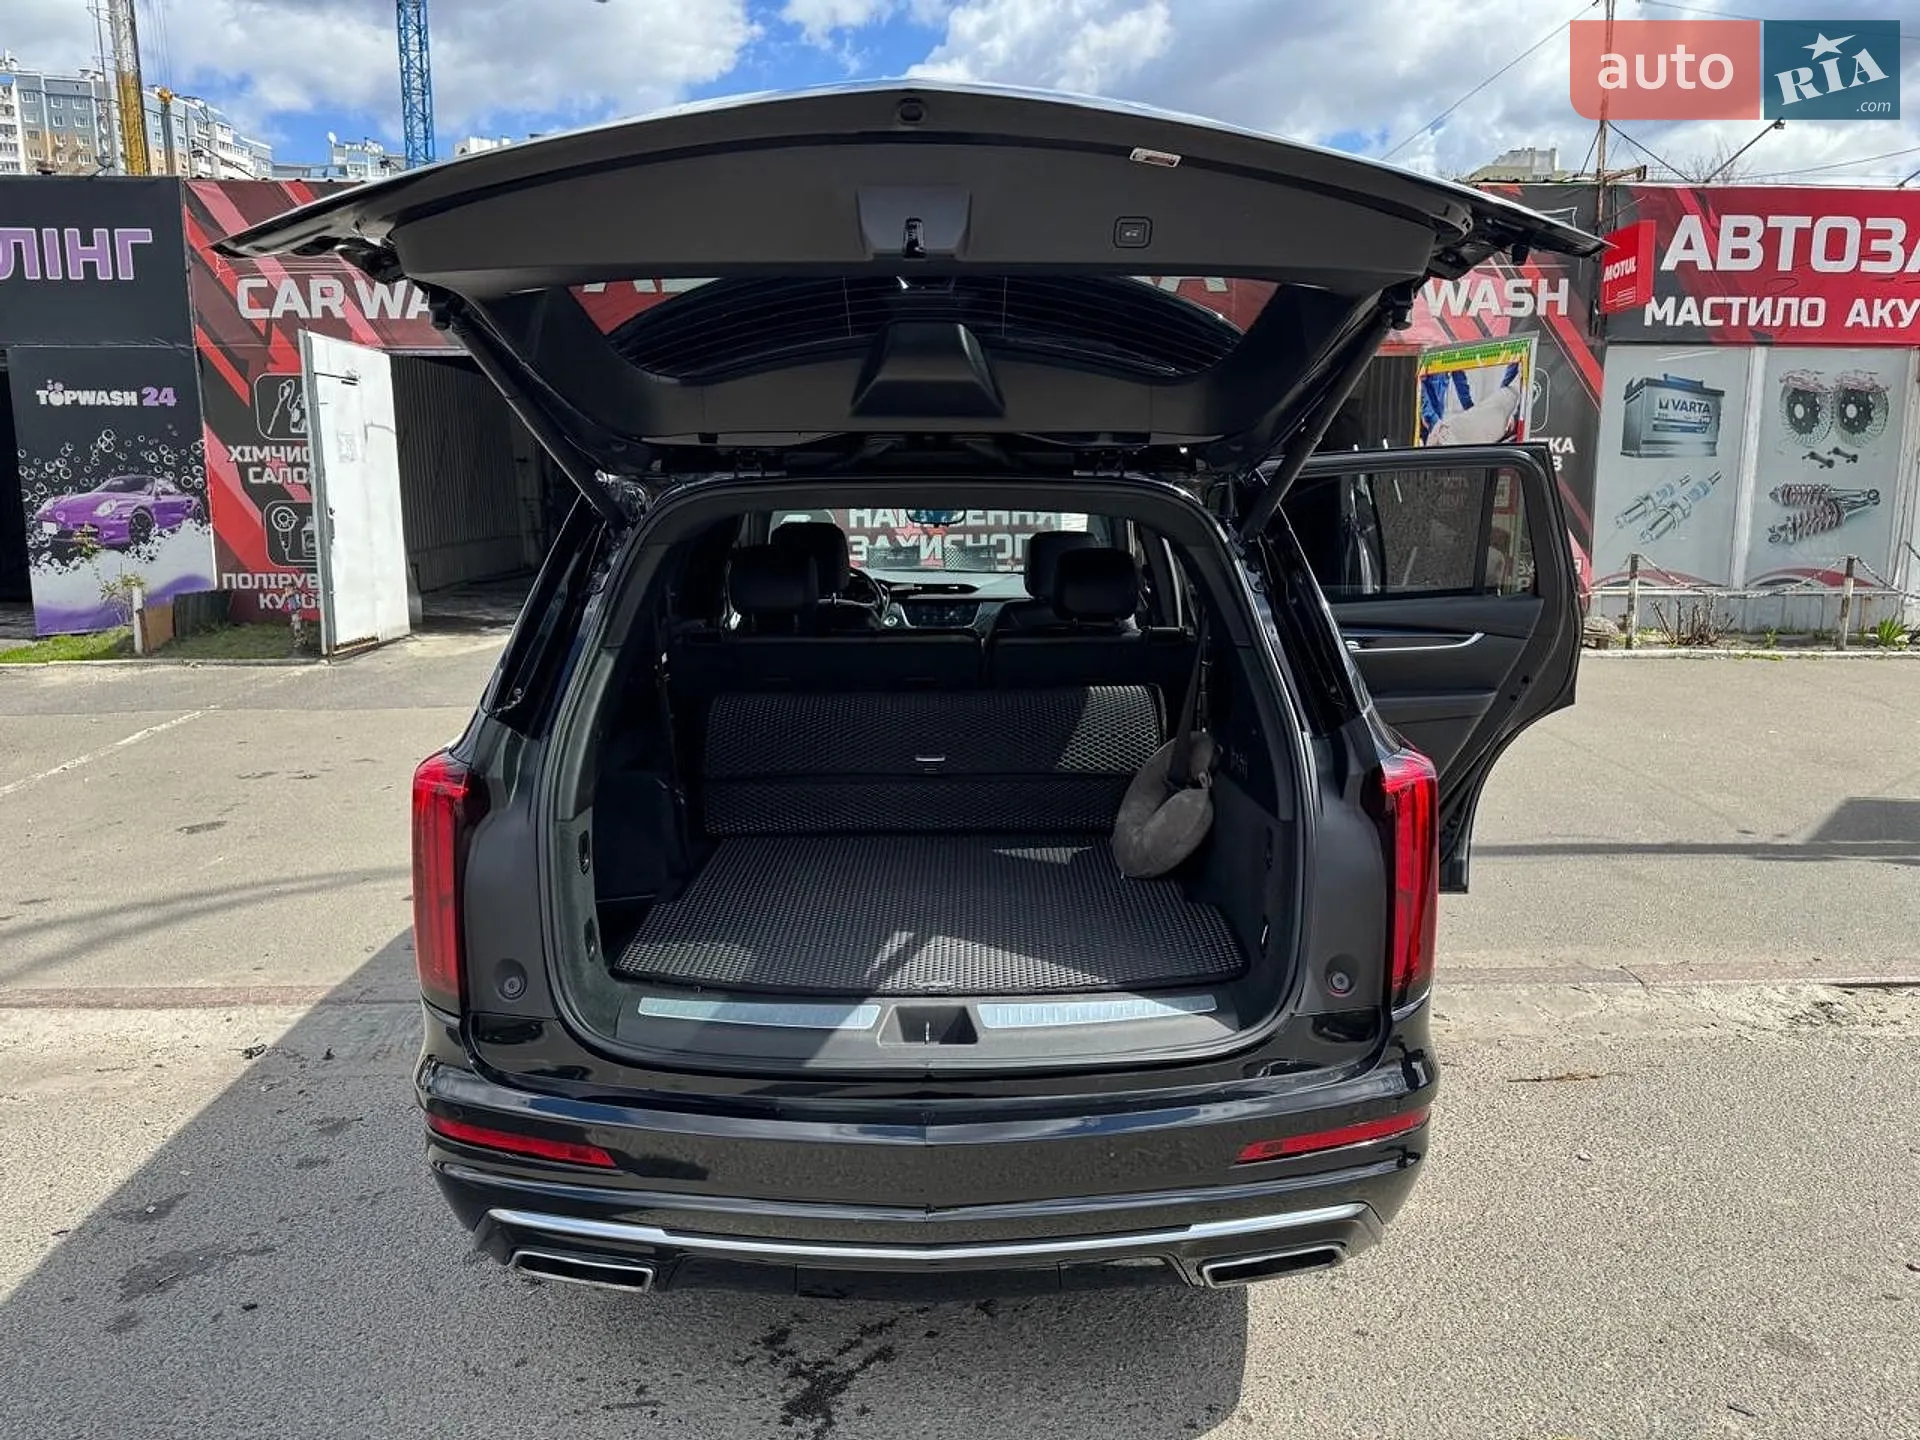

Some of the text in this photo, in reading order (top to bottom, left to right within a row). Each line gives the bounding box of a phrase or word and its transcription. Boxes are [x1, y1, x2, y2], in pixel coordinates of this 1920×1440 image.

[1603, 256, 1636, 282] MOTUL
[236, 278, 346, 319] CAR
[1424, 278, 1569, 317] WASH
[1645, 296, 1920, 328] МАСТИЛО АКУ
[36, 386, 177, 407] TOPWASH 24
[1671, 398, 1710, 414] VARTA
